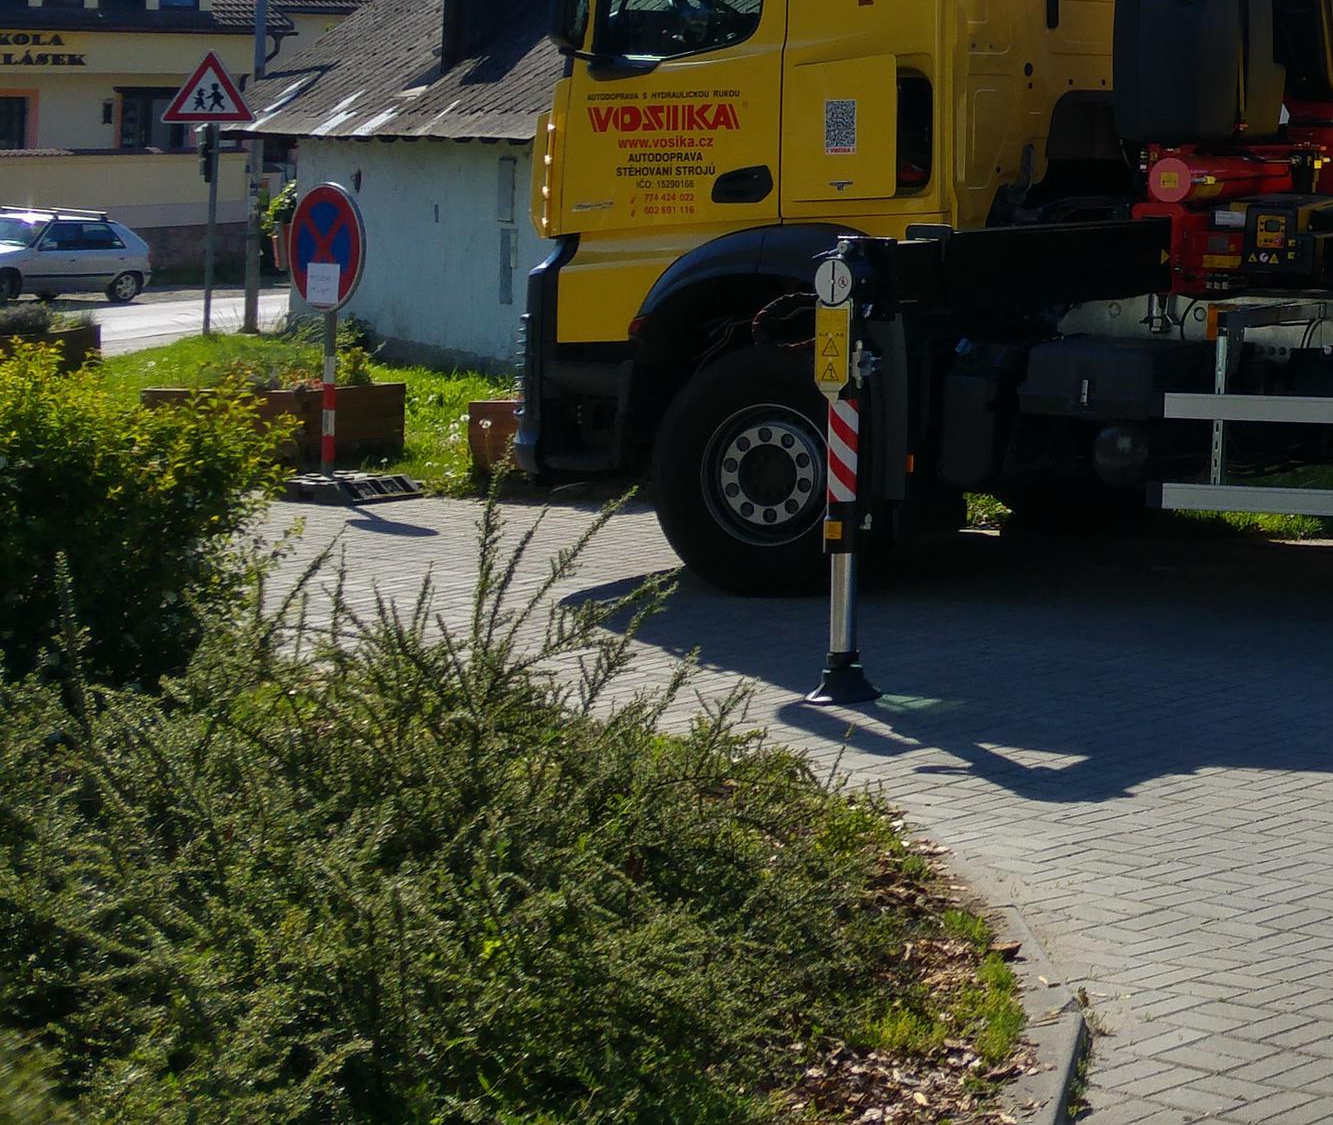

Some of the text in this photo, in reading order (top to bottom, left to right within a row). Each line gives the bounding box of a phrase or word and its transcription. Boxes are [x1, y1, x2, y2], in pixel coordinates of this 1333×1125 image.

[586, 89, 740, 101] AUTODOPRAVA S HYDRAULICKOU RUKOU
[617, 135, 714, 149] www.vosika.cz
[627, 152, 703, 163] AUTODOPRAVA
